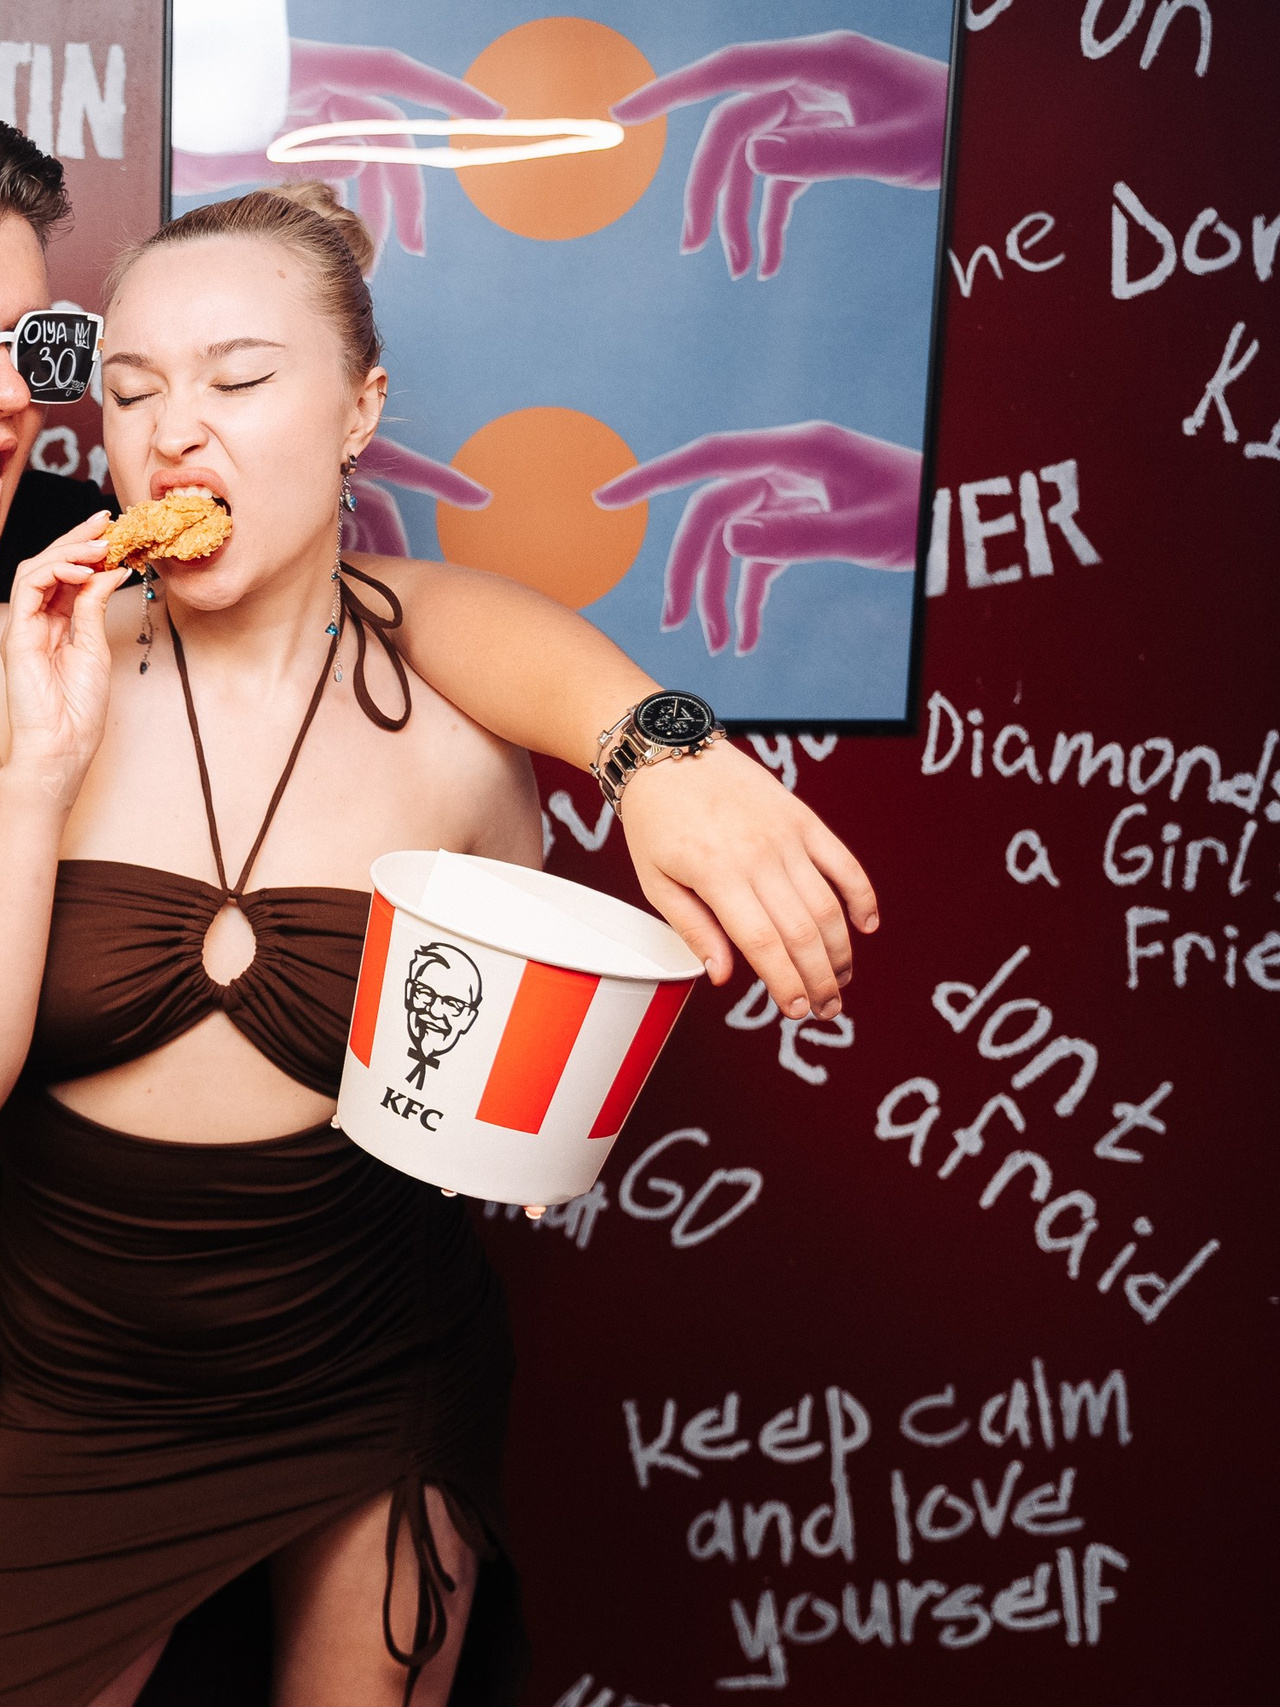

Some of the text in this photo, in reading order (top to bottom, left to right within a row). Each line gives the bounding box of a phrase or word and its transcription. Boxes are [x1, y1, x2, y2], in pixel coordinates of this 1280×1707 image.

[30, 346, 77, 389] 30
[1005, 829, 1061, 888] a
[380, 1086, 444, 1132] KFC
[875, 1076, 1219, 1324] afraid
[899, 1357, 1132, 1451] calm
[687, 1460, 1085, 1566] and love
[717, 1543, 1128, 1690] yourself
